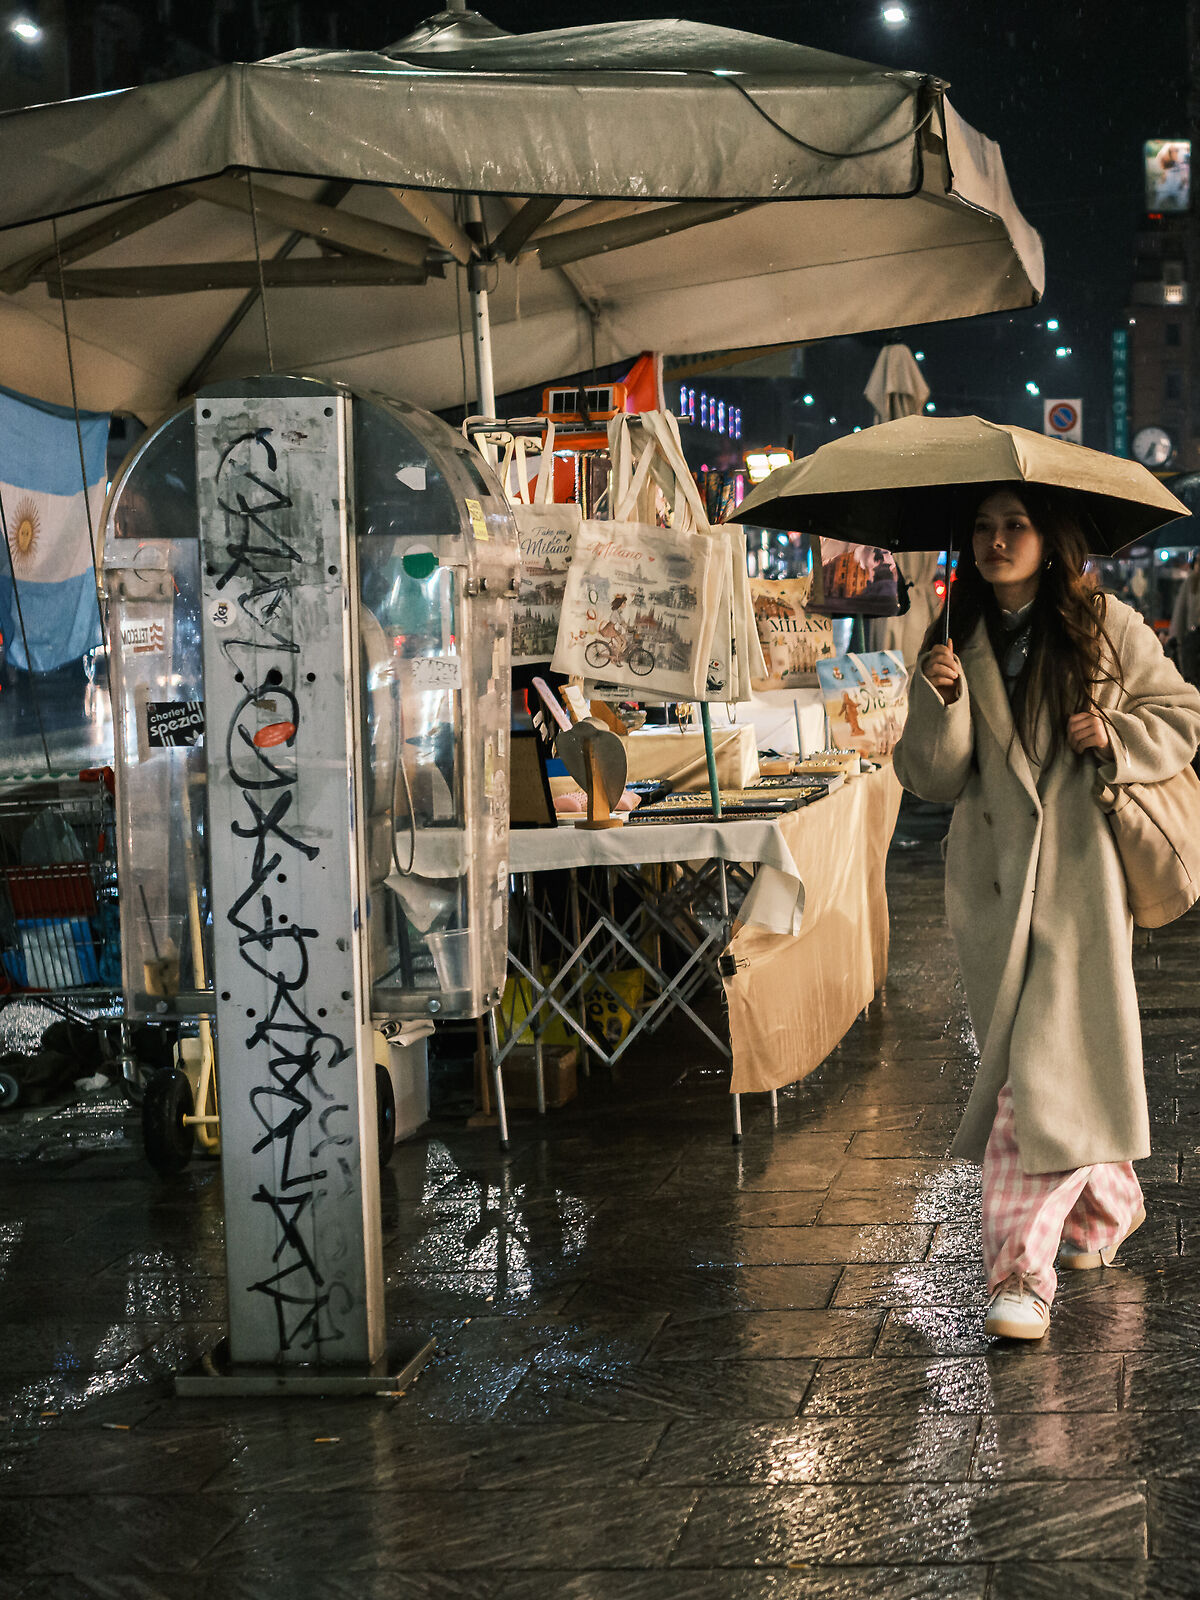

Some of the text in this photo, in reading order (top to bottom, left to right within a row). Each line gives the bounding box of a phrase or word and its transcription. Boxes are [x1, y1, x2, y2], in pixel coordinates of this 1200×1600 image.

[532, 526, 554, 537] Take
[520, 538, 570, 558] Milano
[587, 541, 643, 561] Milano
[769, 618, 832, 633] MILANO
[150, 707, 186, 722] chorley
[150, 708, 204, 740] spezial
